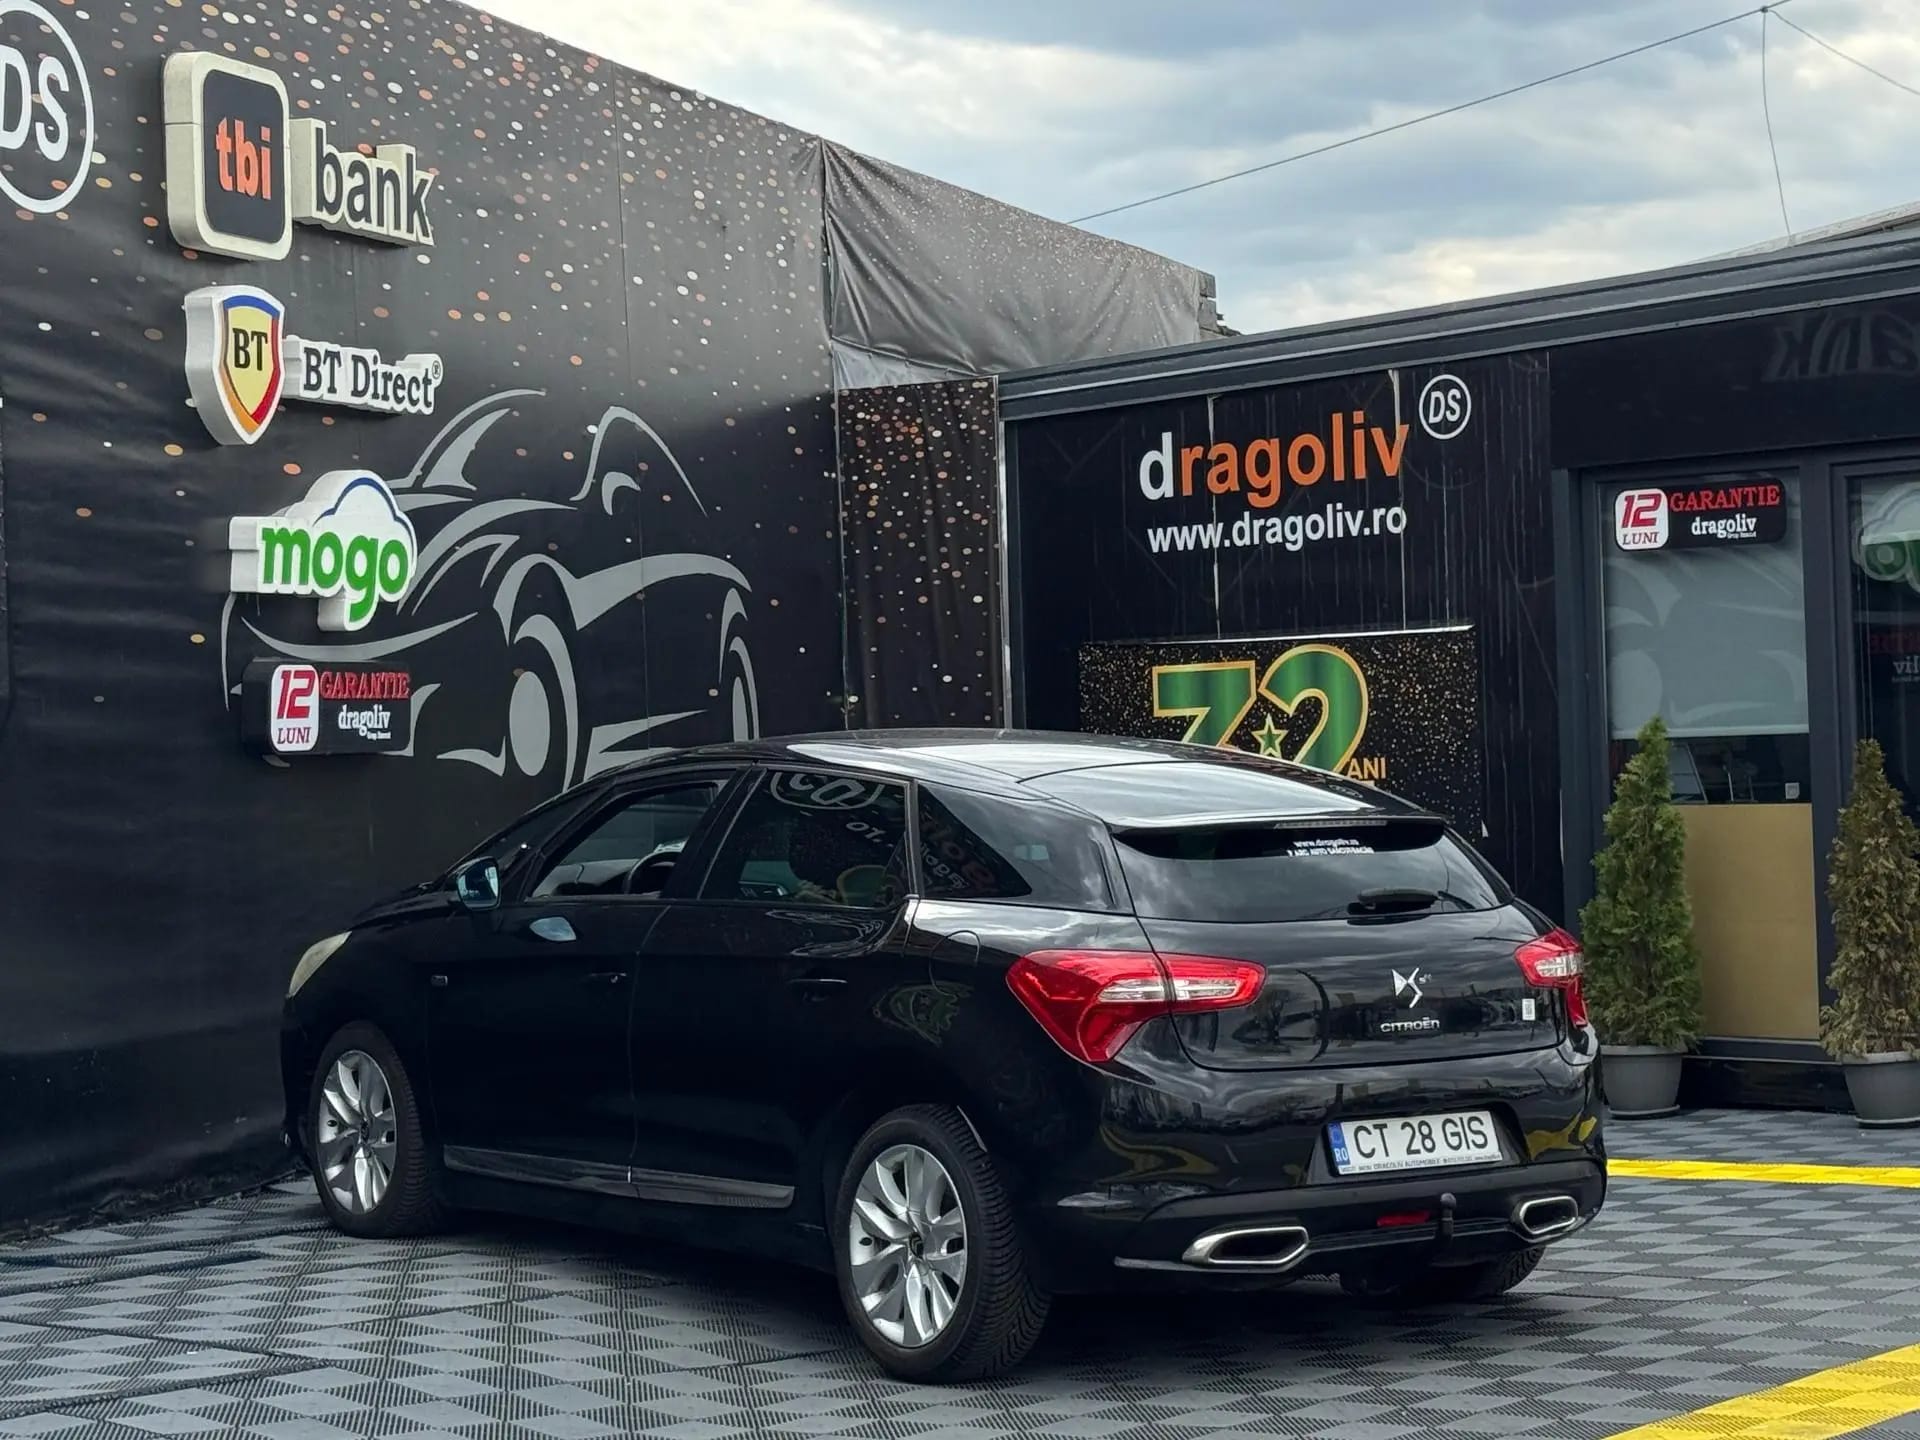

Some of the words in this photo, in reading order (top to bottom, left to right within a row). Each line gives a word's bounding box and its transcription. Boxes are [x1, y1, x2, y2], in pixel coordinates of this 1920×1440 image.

[0, 44, 69, 161] DS
[216, 116, 272, 199] tbi
[315, 127, 432, 239] bank
[232, 327, 268, 371] BT
[304, 347, 341, 394] BT
[1429, 387, 1462, 425] DS
[1139, 410, 1409, 507] dragoliv
[1621, 493, 1662, 529] 12
[1670, 485, 1780, 512] GARANTIE
[1147, 505, 1408, 553] www.dragoliv.ro
[1622, 531, 1660, 545] LUNI
[1691, 513, 1757, 539] dragoliv
[261, 527, 409, 622] mogo
[277, 670, 316, 719] 12
[320, 671, 411, 699] GARANTIE
[277, 727, 312, 744] LUNI
[338, 704, 391, 736] dragoliv
[1347, 757, 1386, 780] ANI
[1334, 1147, 1349, 1162] RO
[1353, 1122, 1390, 1159] CT
[1400, 1119, 1436, 1155] 28
[1441, 1115, 1488, 1151] GIS
